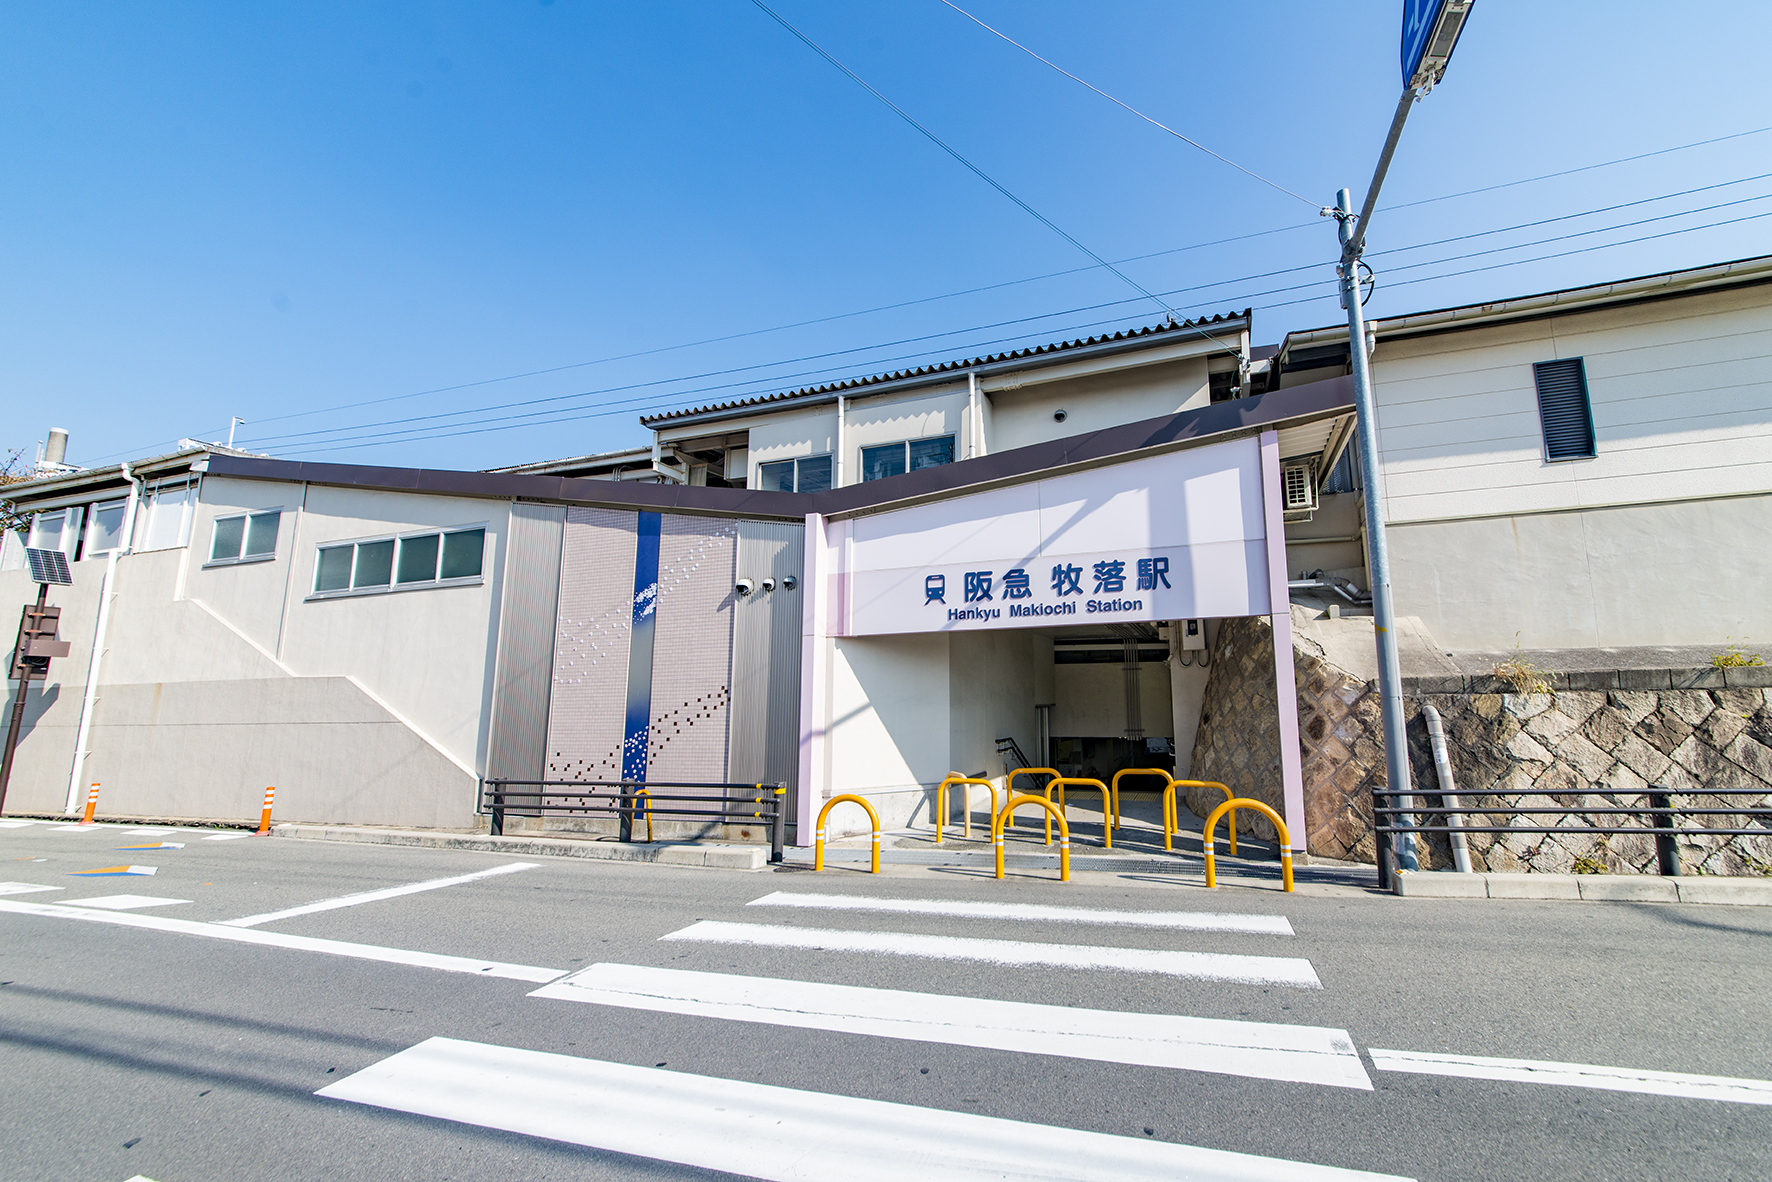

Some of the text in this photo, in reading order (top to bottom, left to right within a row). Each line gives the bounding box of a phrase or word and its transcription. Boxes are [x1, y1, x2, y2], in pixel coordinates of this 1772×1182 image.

[965, 557, 1171, 602] 阪急 牧落駅
[949, 598, 1143, 621] Hankyu Makiochi Station
